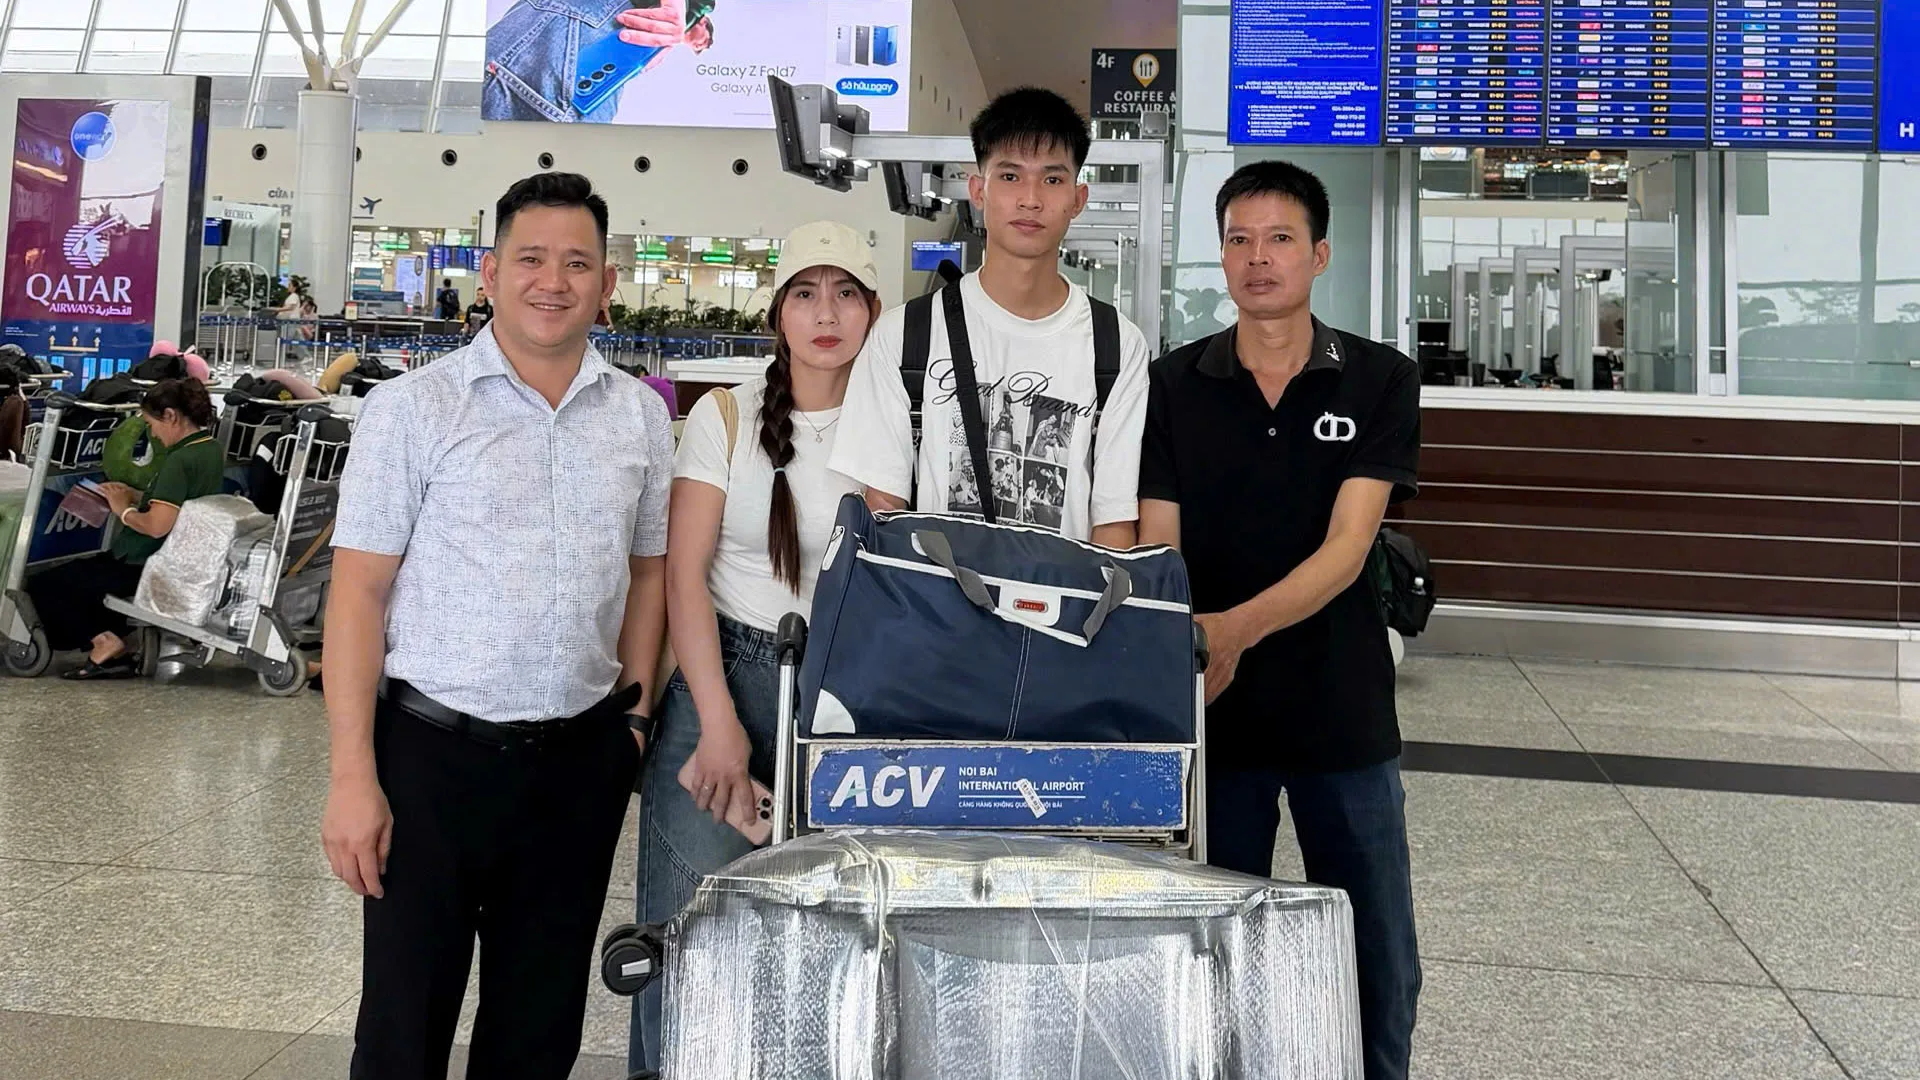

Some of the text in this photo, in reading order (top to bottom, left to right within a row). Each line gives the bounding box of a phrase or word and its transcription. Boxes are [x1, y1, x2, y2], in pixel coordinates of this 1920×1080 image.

[1096, 52, 1115, 69] 4F
[696, 64, 796, 78] Galaxy Z Fold7
[711, 82, 766, 95] Galaxy AI
[1113, 91, 1164, 102] COFFEE
[1900, 122, 1914, 138] H
[26, 273, 132, 306] QATAR
[48, 303, 95, 315] AIRWAYS
[95, 305, 132, 316] القطرية
[959, 766, 997, 776] NOI BAI
[829, 766, 946, 808] ACV
[958, 781, 1085, 791] INTERNATIOL AIRPORT
